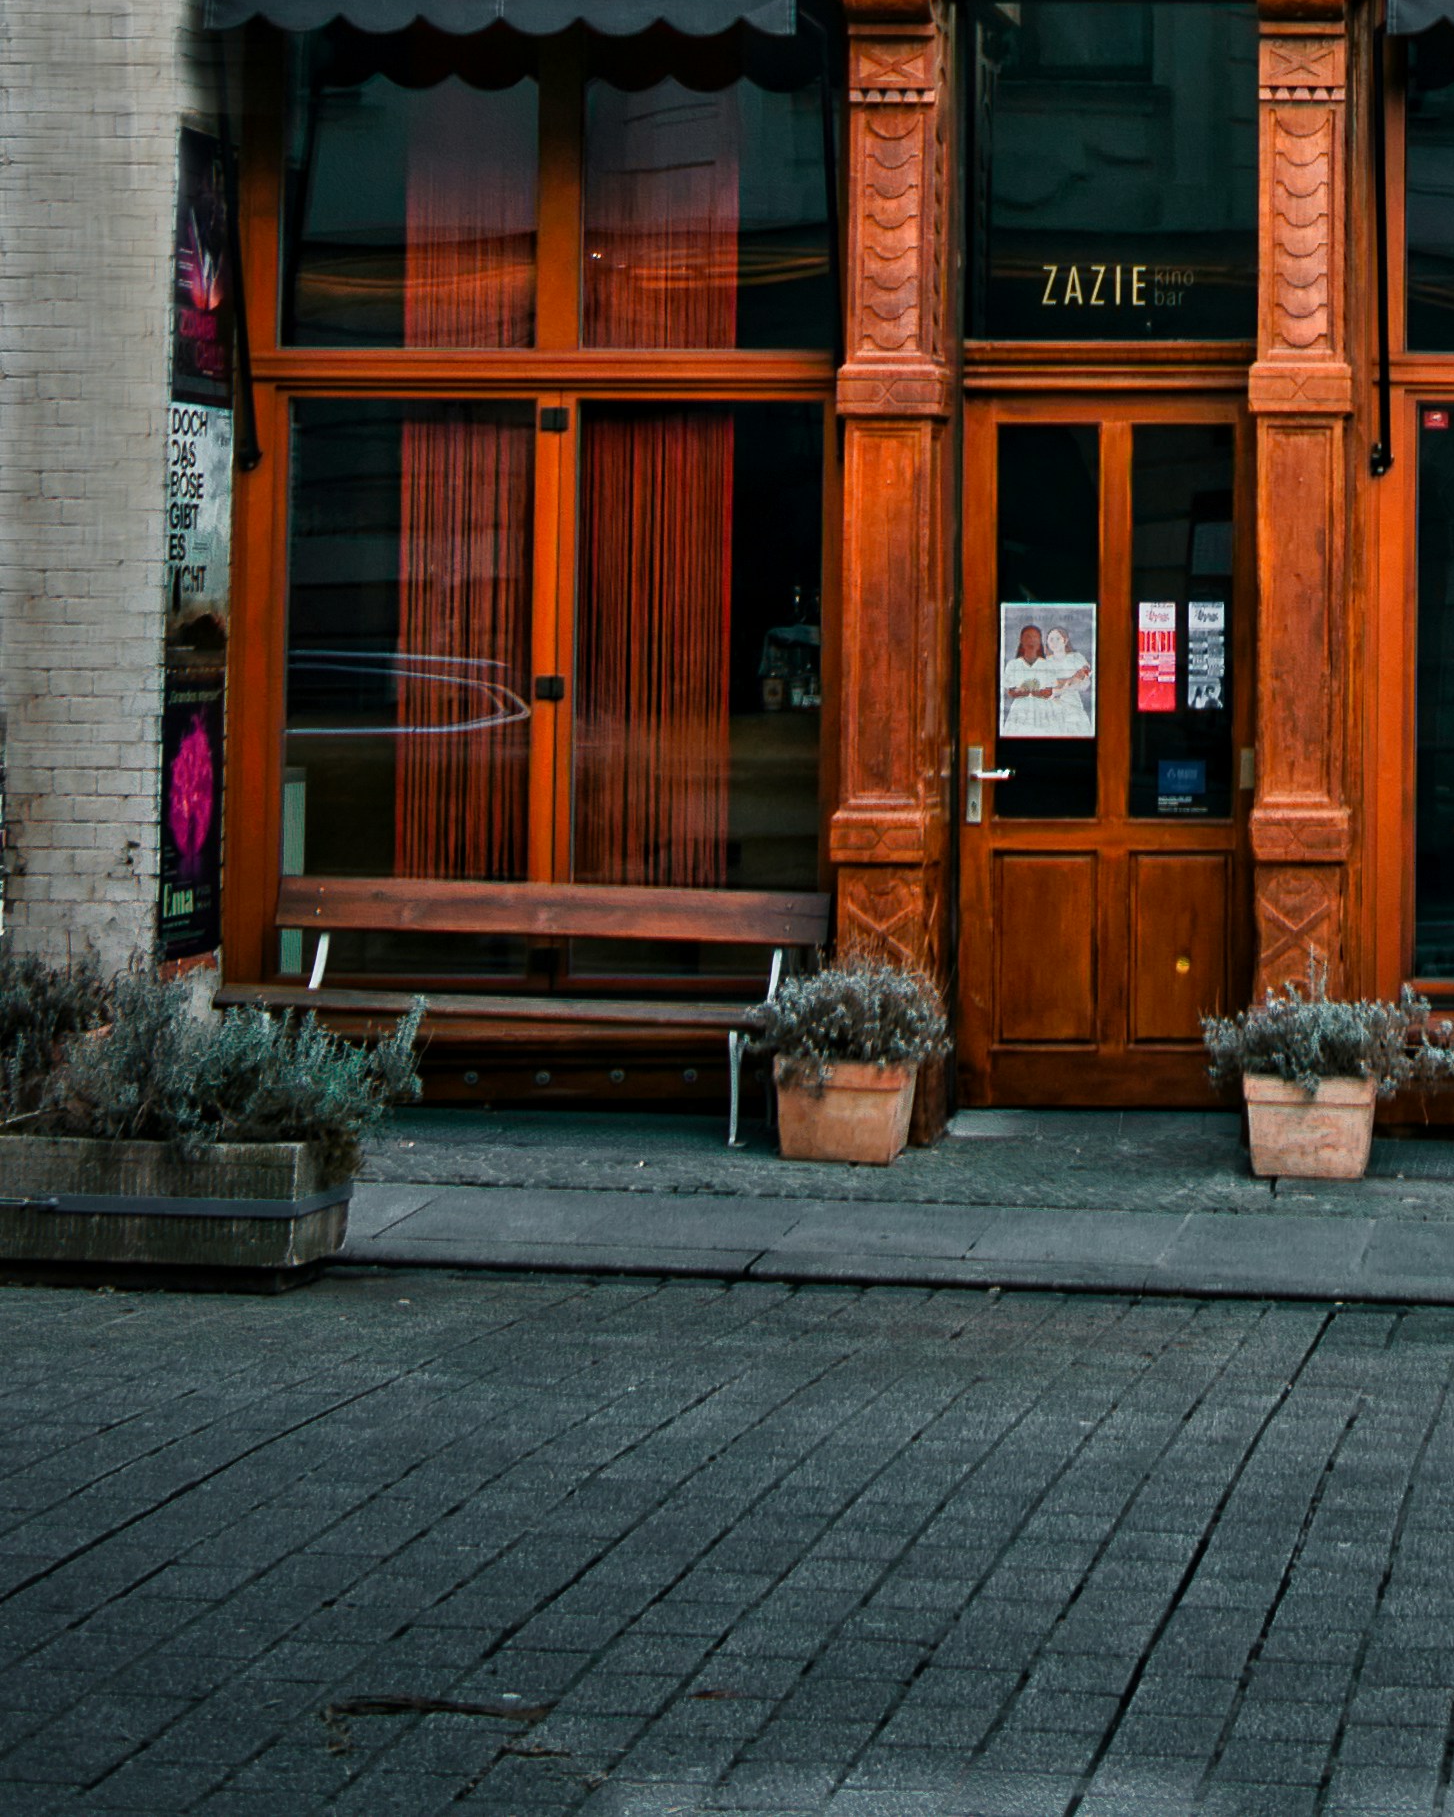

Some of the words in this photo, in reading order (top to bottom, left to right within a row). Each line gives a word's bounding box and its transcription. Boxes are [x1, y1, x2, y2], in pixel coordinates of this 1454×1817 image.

[1041, 264, 1148, 307] ZAZIE
[1154, 266, 1195, 286] kino
[1154, 287, 1185, 307] bar
[171, 407, 208, 437] DOCH
[168, 501, 200, 531] GIBT
[167, 533, 188, 562] ES
